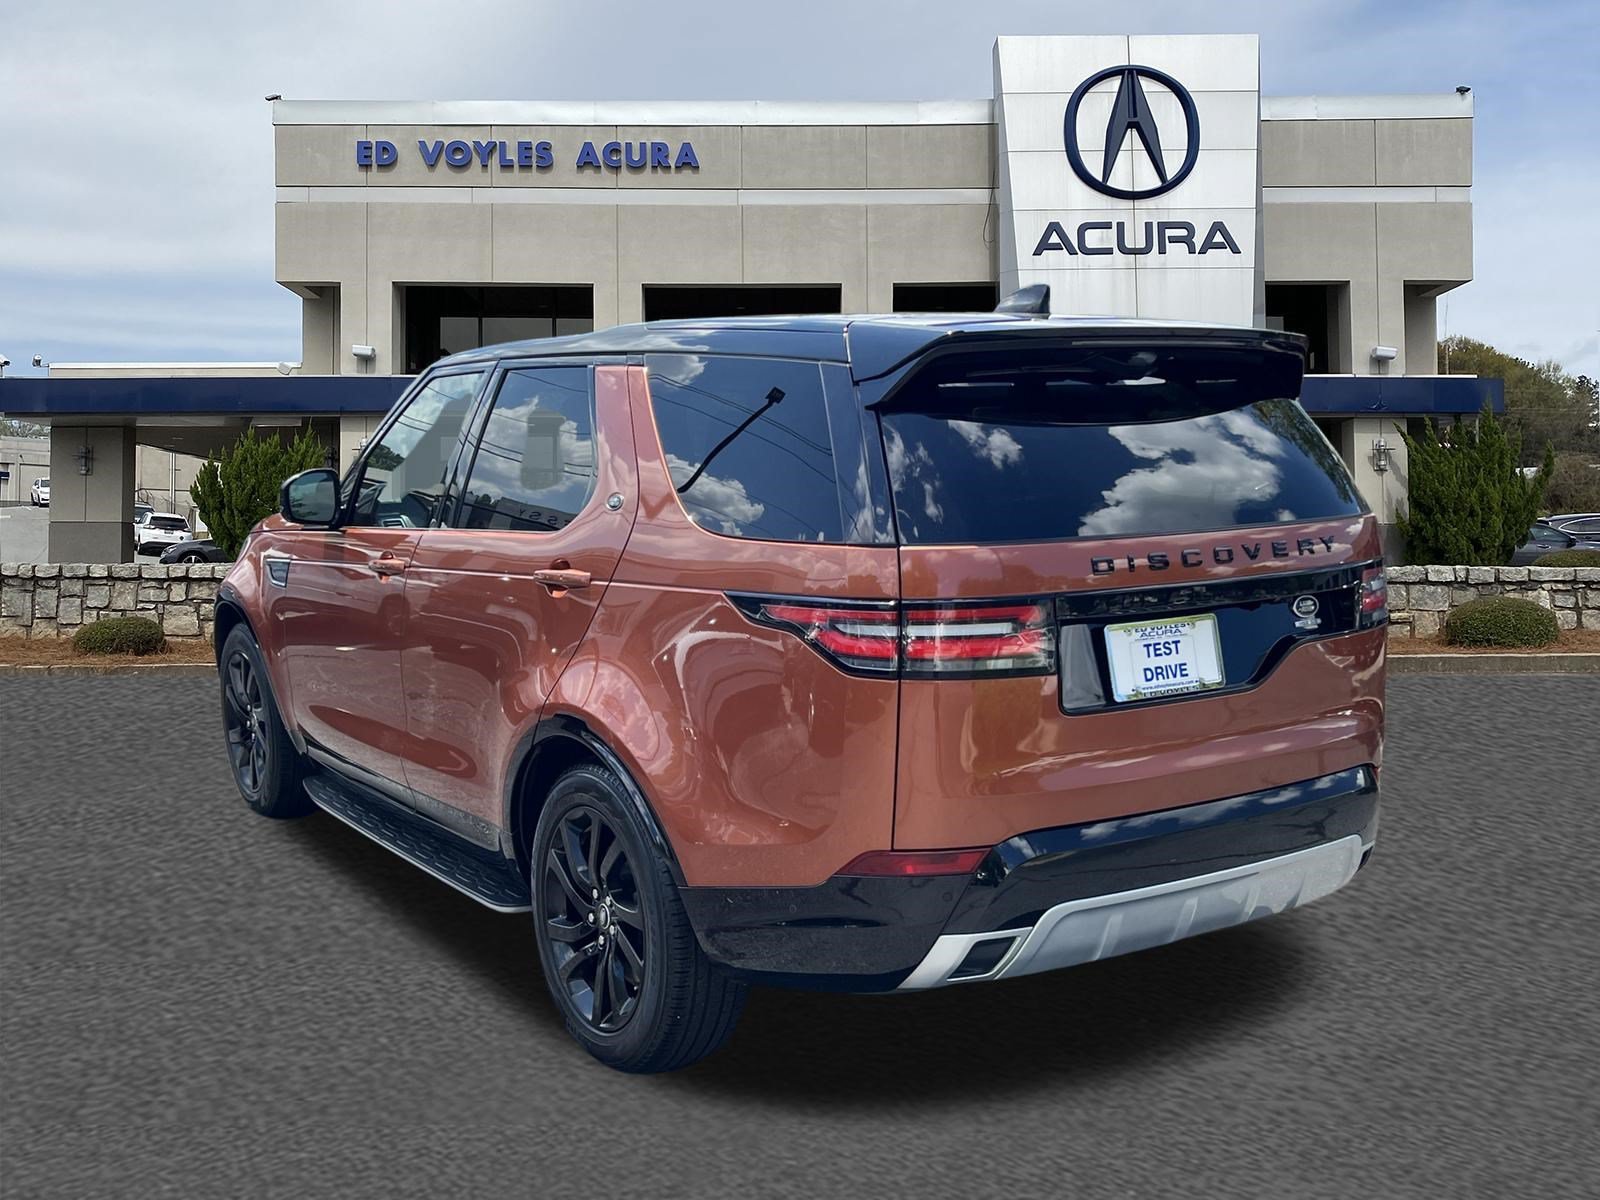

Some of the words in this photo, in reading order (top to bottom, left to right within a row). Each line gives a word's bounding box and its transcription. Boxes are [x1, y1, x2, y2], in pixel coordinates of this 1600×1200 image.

[356, 140, 398, 166] ED
[417, 140, 554, 167] VOYLES
[576, 141, 700, 168] ACURA
[1032, 221, 1242, 256] ACURA
[1091, 535, 1335, 576] DISCOVERY
[1139, 628, 1182, 638] ACURA
[1143, 640, 1181, 658] TEST
[1143, 662, 1189, 682] DRIVE
